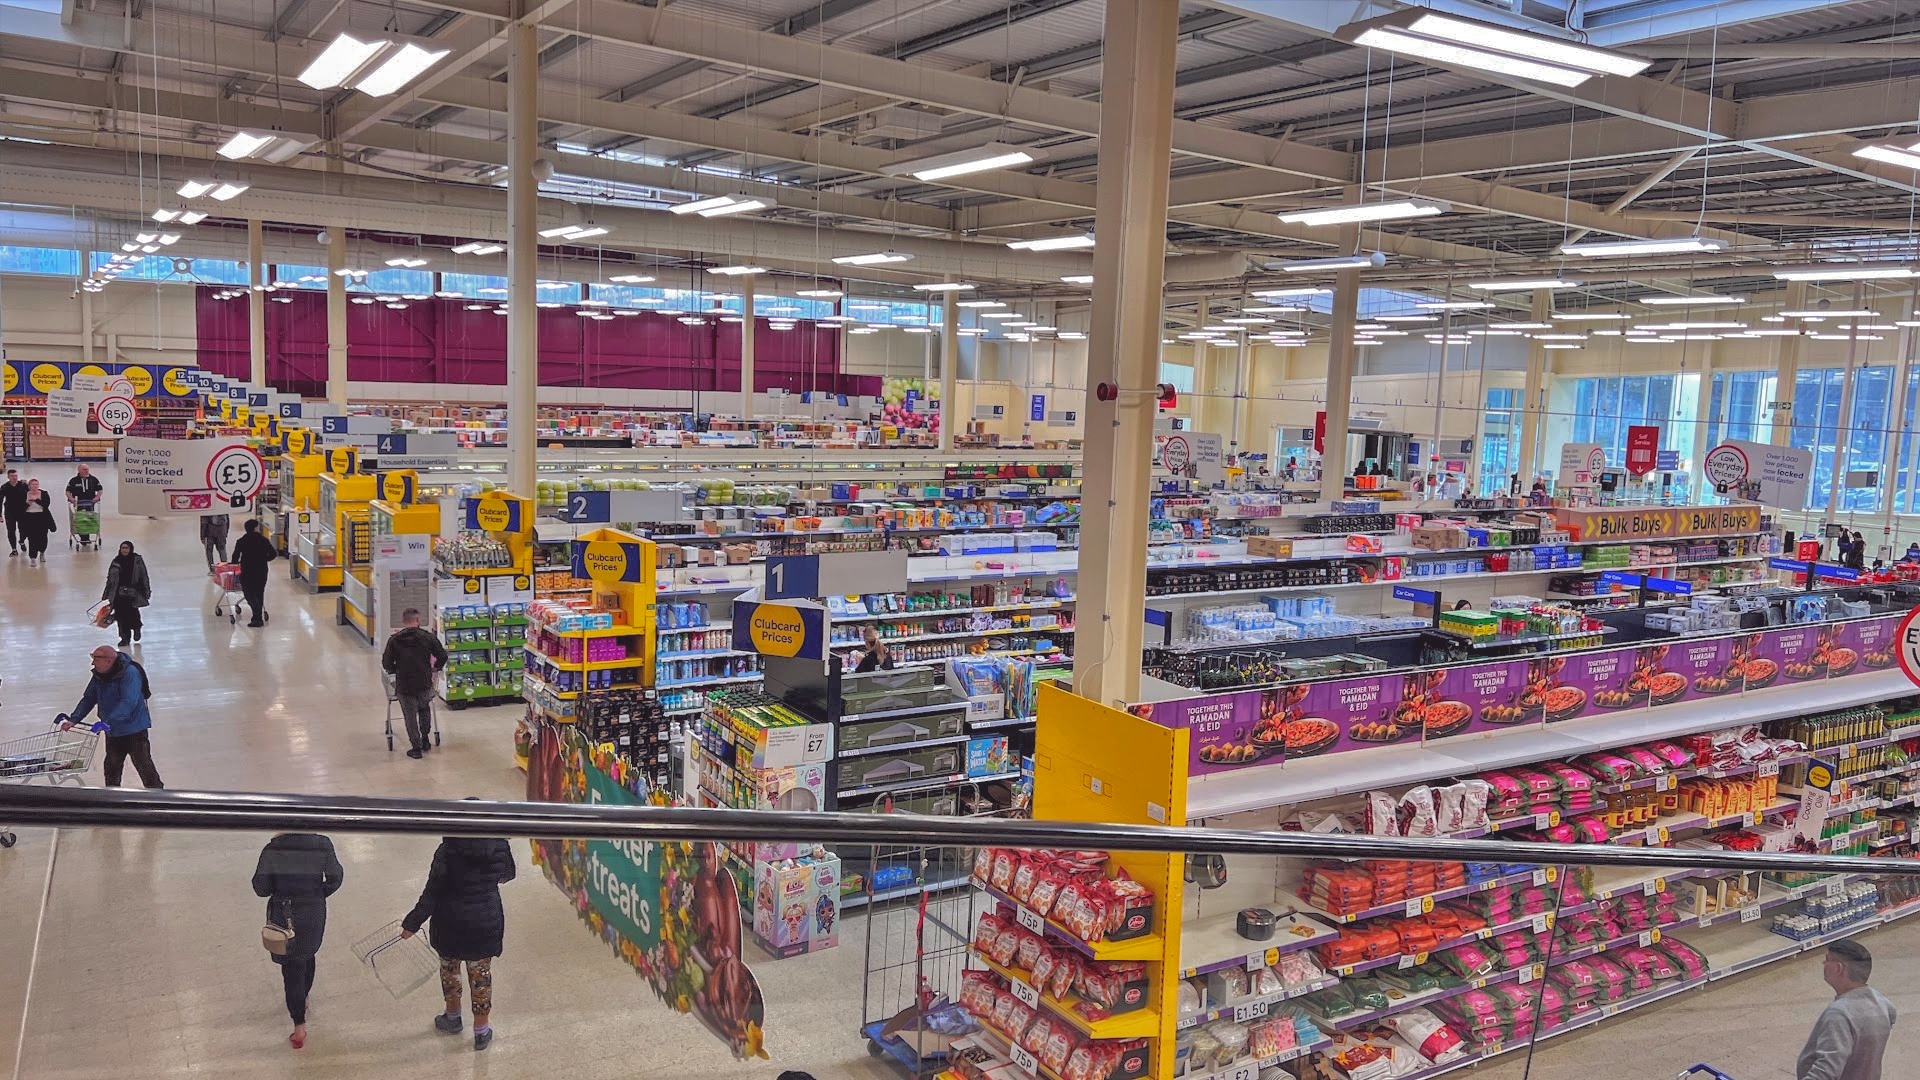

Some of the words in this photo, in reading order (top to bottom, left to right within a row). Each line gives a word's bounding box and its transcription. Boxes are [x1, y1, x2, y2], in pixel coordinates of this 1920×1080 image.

[230, 389, 238, 397] 8
[251, 395, 257, 405] 7
[106, 410, 129, 420] 85p
[282, 406, 290, 416] 6
[998, 406, 1003, 414] 8
[326, 419, 335, 431] 5
[1308, 430, 1313, 439] 5
[380, 438, 392, 452] 4
[1167, 449, 1187, 458] Everyday
[1720, 454, 1735, 462] Low
[142, 458, 168, 466] prices
[1592, 459, 1600, 470] £5
[1708, 459, 1745, 473] Everyday
[1776, 462, 1795, 471] prices
[145, 467, 183, 476] locked
[222, 464, 250, 485] £5
[1714, 469, 1736, 479] Prices
[1777, 469, 1804, 479] locked
[385, 482, 403, 490] Clubcard
[480, 508, 507, 516] Clubcard
[573, 496, 588, 518] 2
[1601, 518, 1628, 534] Bulk
[1632, 516, 1661, 536] Buys
[1693, 514, 1717, 530] Bulk
[1722, 513, 1747, 532] Buys
[408, 542, 425, 550] Win
[587, 552, 623, 562] Clubcard
[593, 562, 618, 572] Prices
[771, 562, 784, 594] 1
[754, 618, 801, 633] Clubcard
[761, 631, 793, 644] Prices
[1689, 647, 1709, 655] TOGETHER
[1690, 652, 1715, 661] RAMADAN
[1472, 671, 1496, 680] TOGETHER
[1497, 669, 1508, 677] THIS
[1588, 665, 1616, 674] RAMADAN
[1474, 677, 1505, 688] RAMADAN
[1594, 674, 1598, 682] &
[1600, 673, 1609, 681] EID
[1339, 686, 1367, 696] TOGETHER
[1486, 686, 1497, 694] EID
[1341, 692, 1377, 703] RAMADAN
[1187, 704, 1218, 715] TOGETHER
[1220, 702, 1234, 710] THIS
[1350, 704, 1355, 712] &
[1356, 703, 1368, 711] EID
[1190, 711, 1230, 724] RAMADAN
[1199, 724, 1205, 732] &
[1207, 722, 1220, 731] EID
[808, 740, 823, 752] £7
[970, 750, 983, 758] SAND
[970, 757, 986, 768] WATER
[1760, 764, 1778, 775] £8.40
[1802, 791, 1816, 821] Cooking
[1814, 795, 1824, 809] Oils
[1836, 839, 1846, 848] £15
[591, 850, 650, 935] treats
[1831, 883, 1842, 895] £15
[1742, 909, 1759, 921] £13.50
[1236, 1002, 1266, 1020] £1.50
[1182, 1018, 1196, 1026] £1.50
[1236, 1070, 1249, 1080] £2
